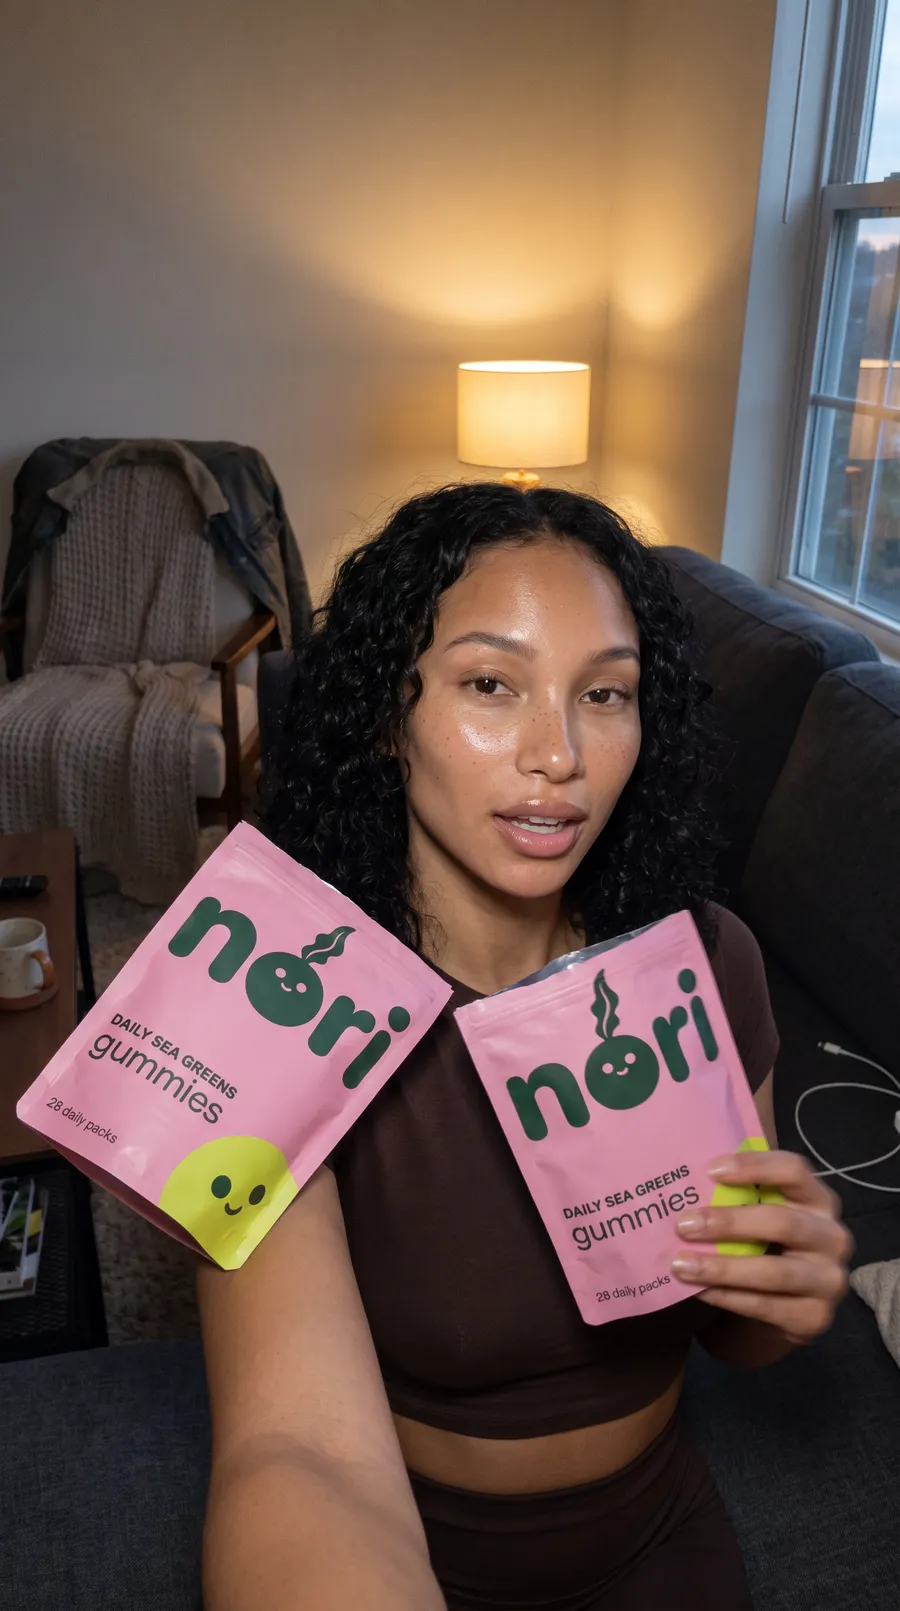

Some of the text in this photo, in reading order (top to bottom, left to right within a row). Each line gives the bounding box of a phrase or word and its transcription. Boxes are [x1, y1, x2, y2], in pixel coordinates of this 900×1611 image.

[168, 896, 411, 1090] nori
[88, 1034, 223, 1124] gummies
[110, 1013, 238, 1100] DAILY SEA GREENS
[506, 967, 720, 1142] nori
[46, 1097, 118, 1144] 28 daily packs
[562, 1165, 690, 1219] DAILY SEA GREENS
[572, 1186, 700, 1251] gummies
[595, 1275, 671, 1303] 28 daily packs
